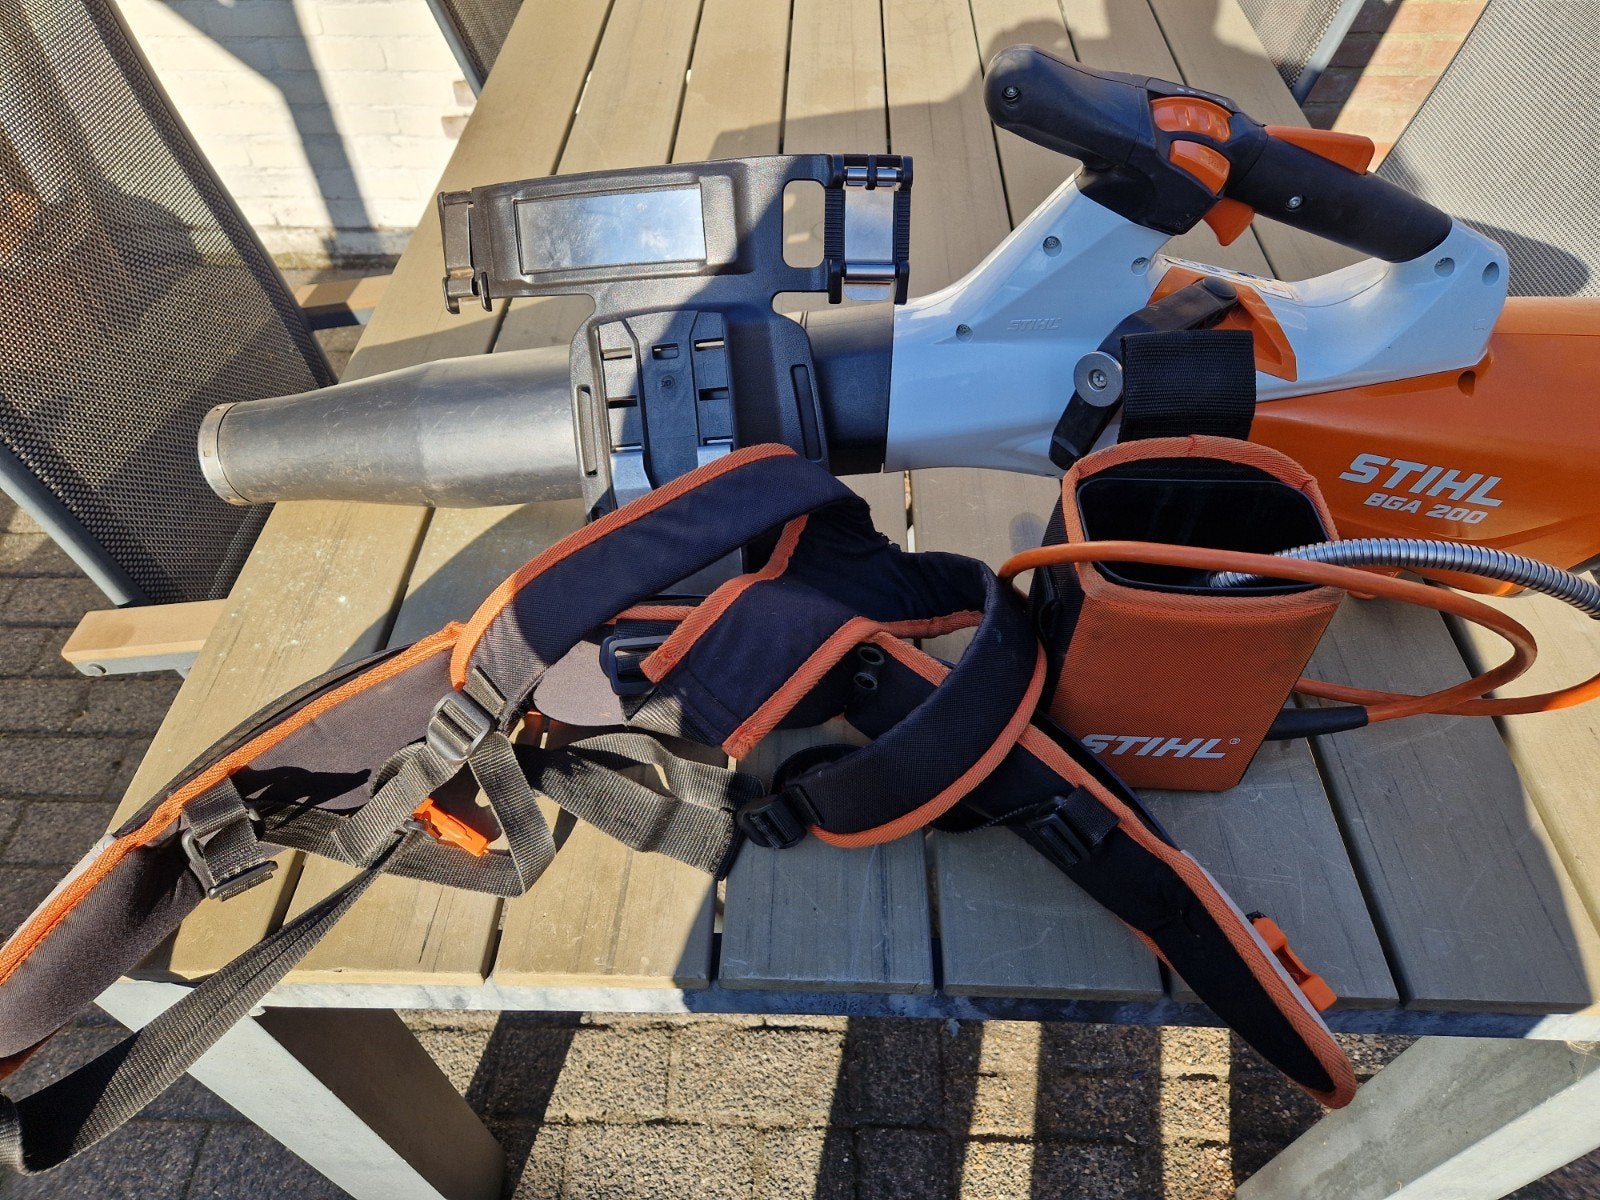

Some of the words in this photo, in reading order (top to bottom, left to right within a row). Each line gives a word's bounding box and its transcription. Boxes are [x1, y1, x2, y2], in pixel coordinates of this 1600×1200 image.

[1007, 317, 1060, 332] STIHL
[1339, 453, 1503, 507] STIHL
[1363, 493, 1422, 514] BGA
[1425, 504, 1489, 524] 200
